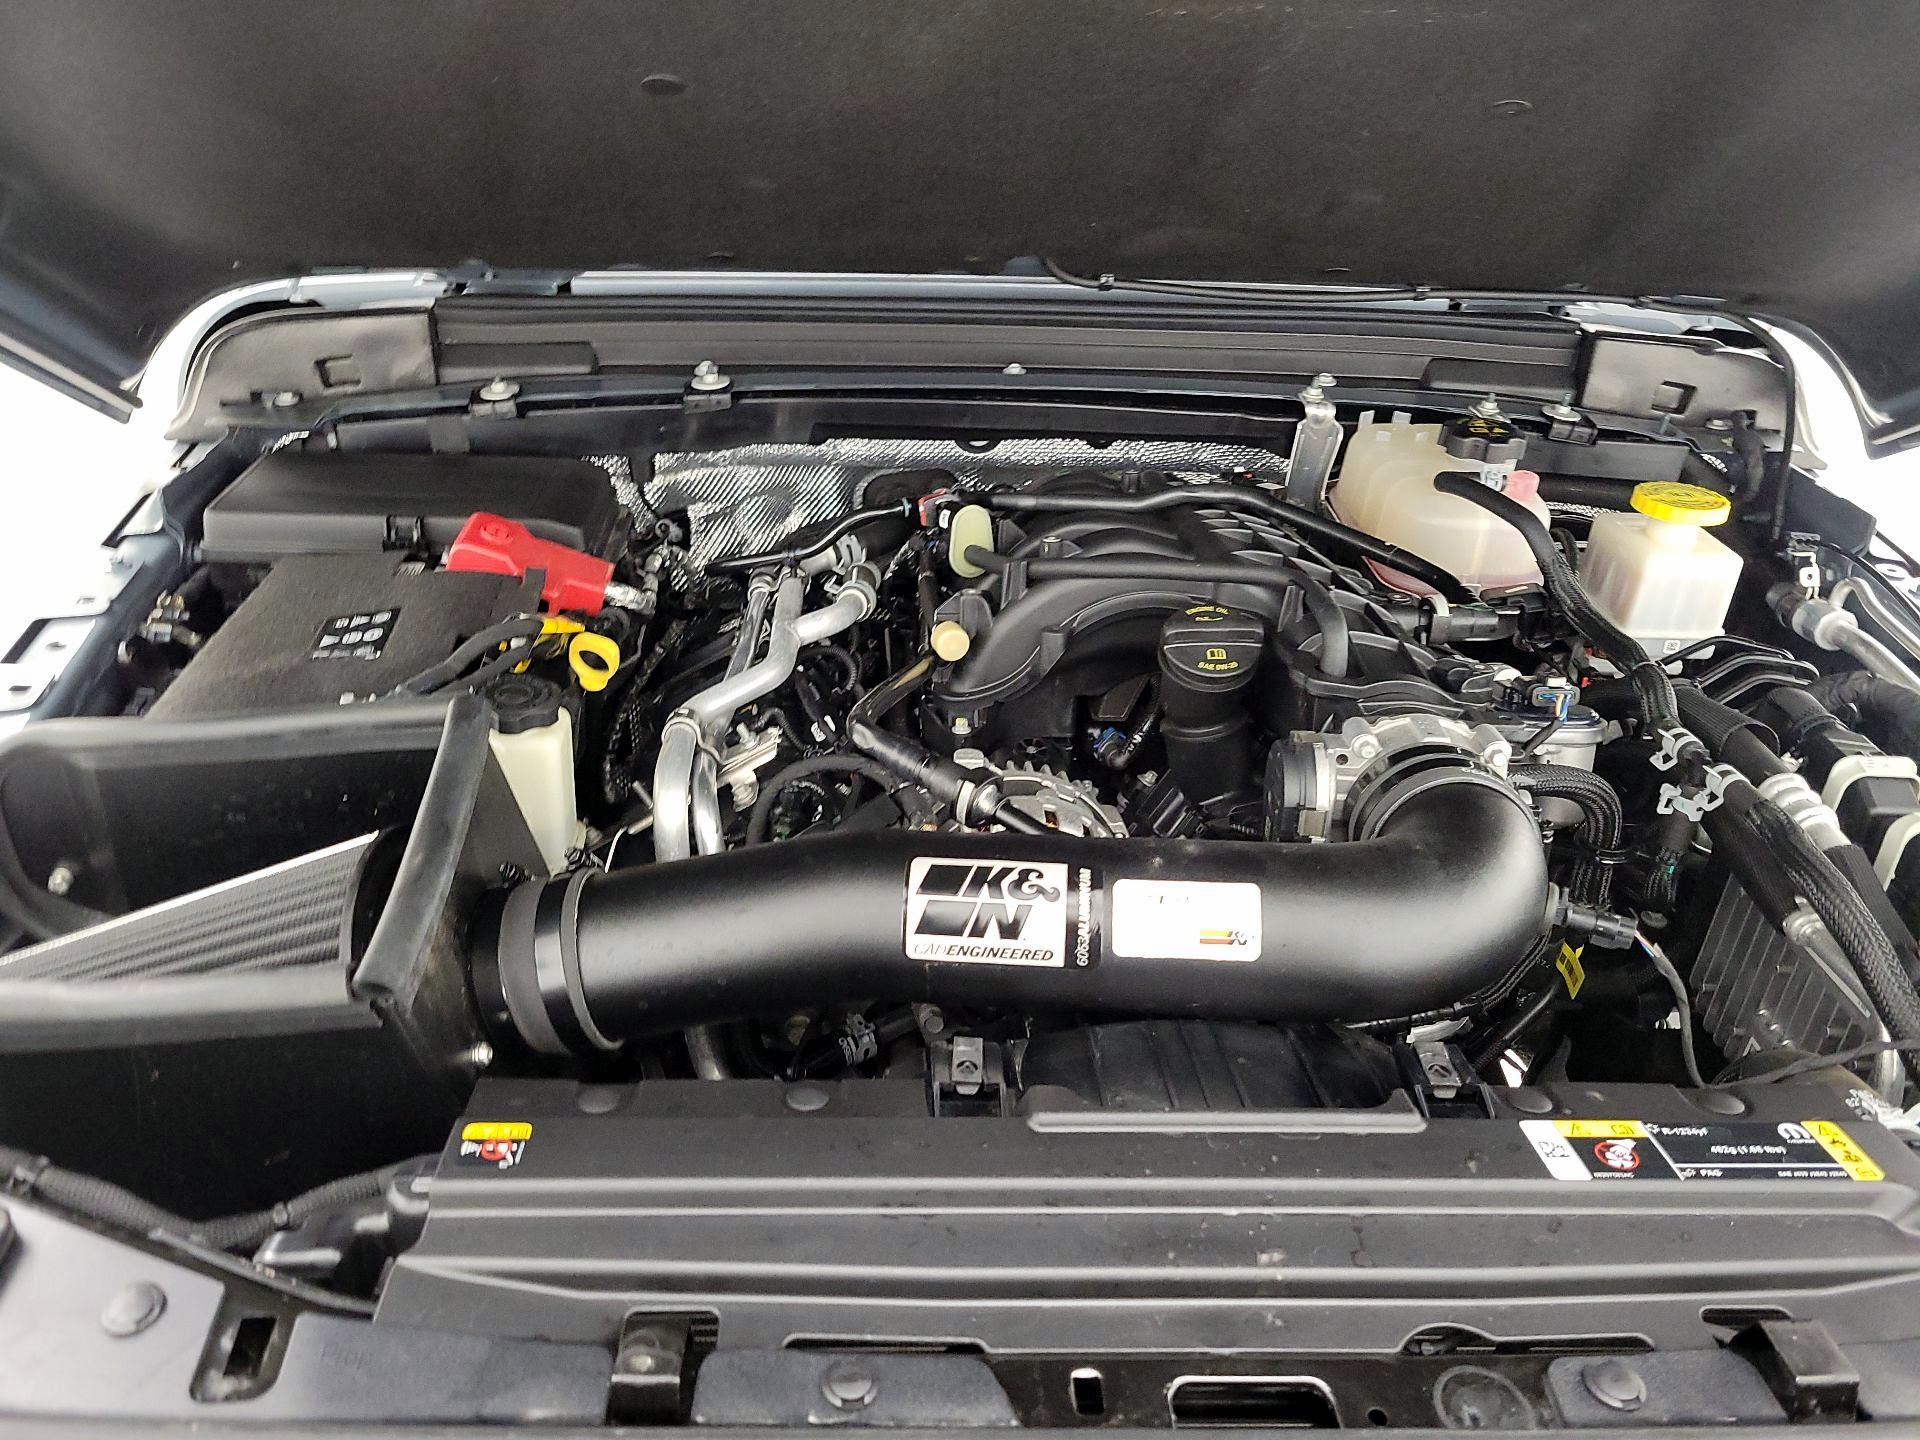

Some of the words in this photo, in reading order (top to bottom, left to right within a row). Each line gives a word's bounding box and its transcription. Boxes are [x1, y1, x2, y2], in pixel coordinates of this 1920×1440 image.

[1184, 606, 1215, 616] ENGINE
[1216, 607, 1229, 615] OIL
[1198, 661, 1215, 671] SAE
